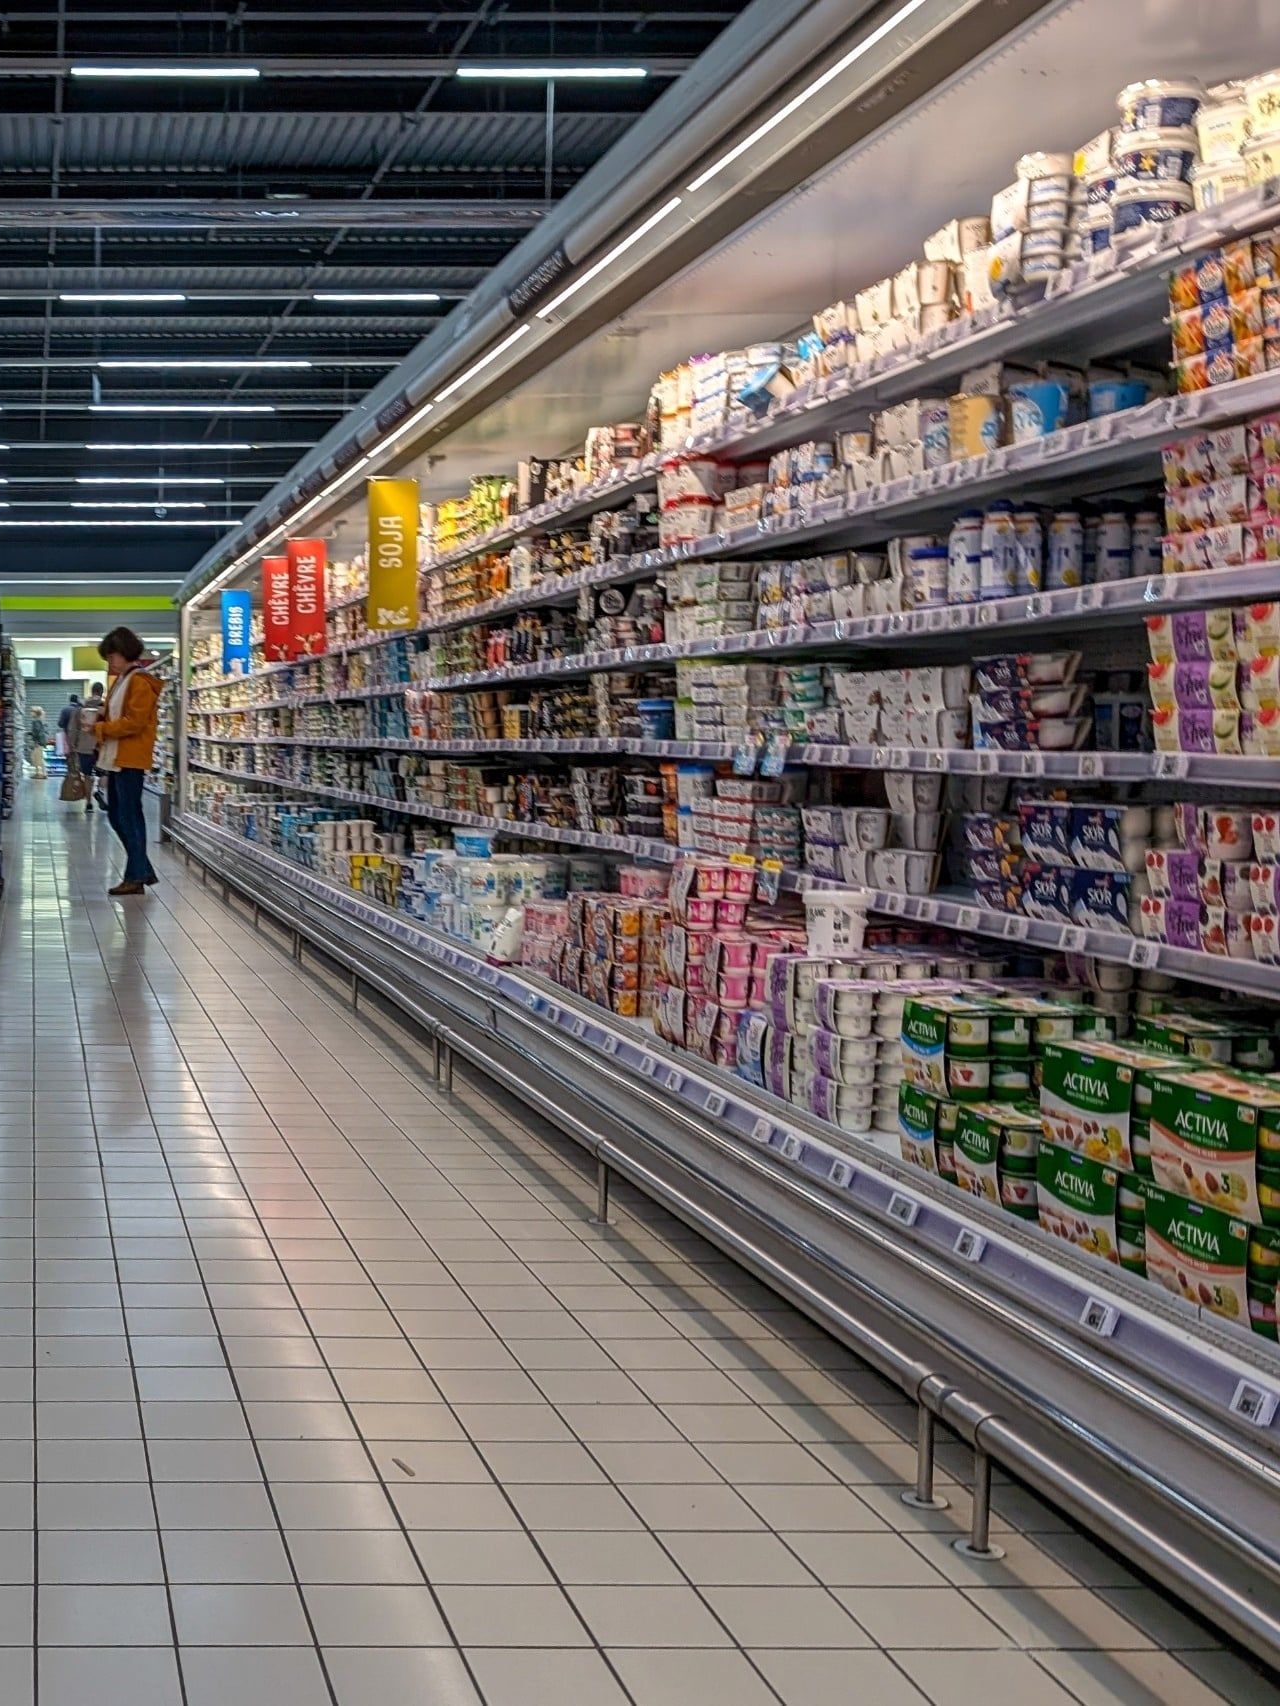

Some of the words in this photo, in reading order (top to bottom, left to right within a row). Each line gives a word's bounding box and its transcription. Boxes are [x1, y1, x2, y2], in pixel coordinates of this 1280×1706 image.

[378, 515, 404, 568] SOJA
[227, 606, 244, 646] BREBIS
[908, 1019, 938, 1040] ACTIVIA
[1063, 1071, 1110, 1100] ACTIVIA
[903, 1103, 928, 1126] ACTIVIA
[1174, 1108, 1229, 1143] ACTIVIA
[960, 1128, 990, 1153] ACTIVIA
[1055, 1168, 1096, 1202] ACTIVIA
[1167, 1217, 1221, 1256] ACTIVIA
